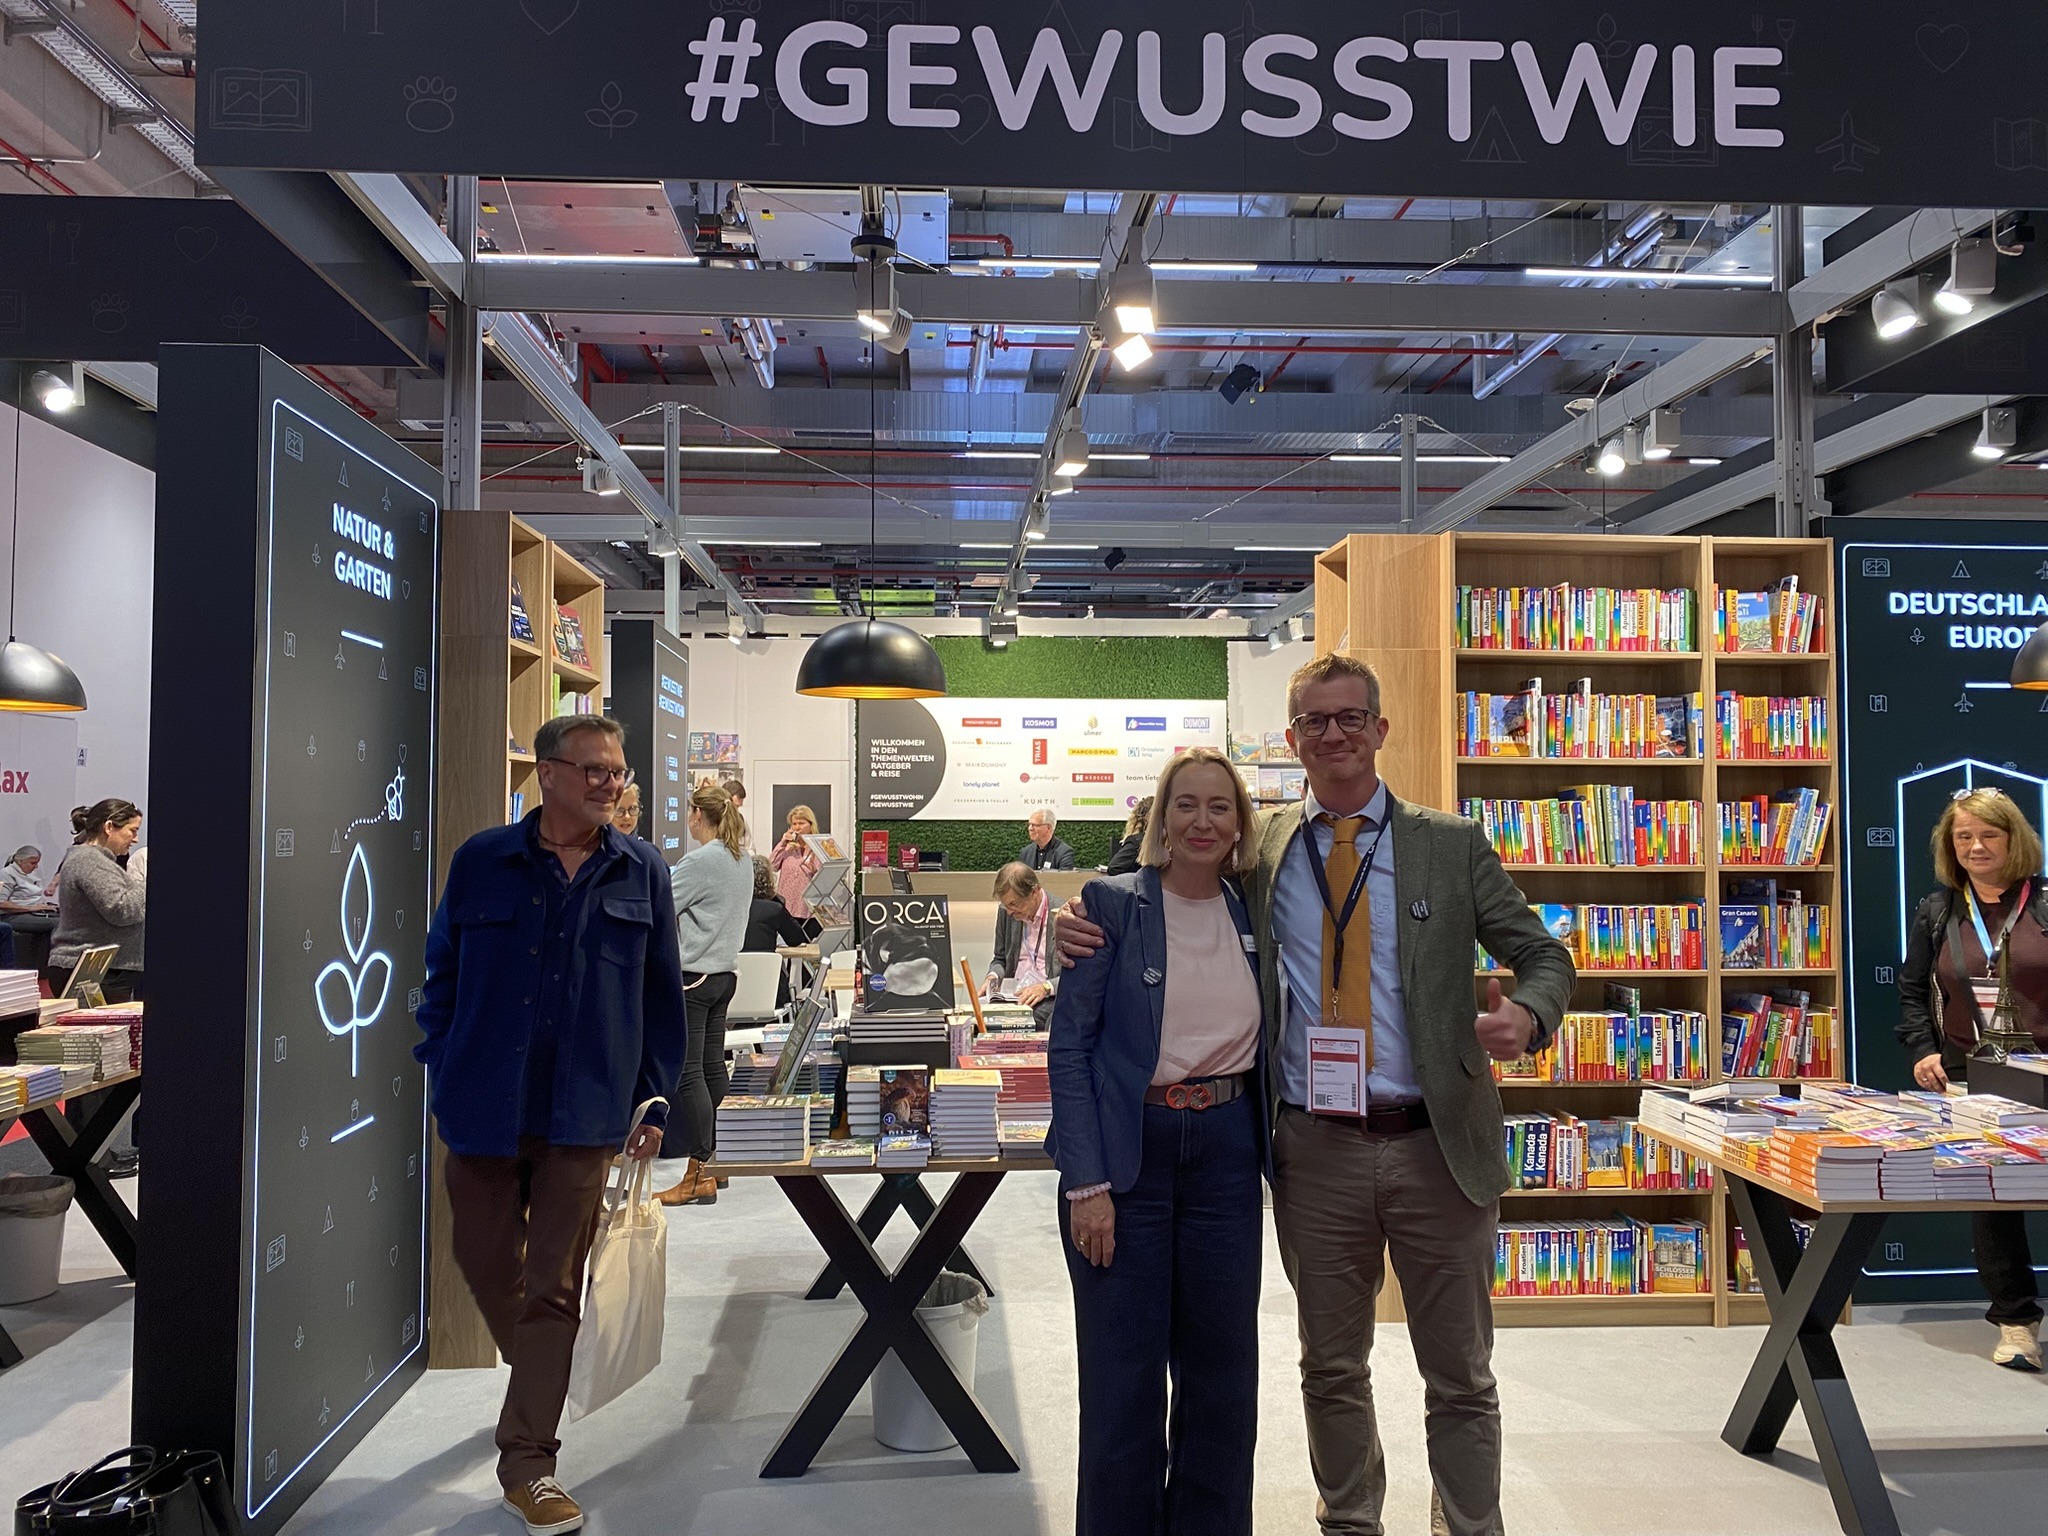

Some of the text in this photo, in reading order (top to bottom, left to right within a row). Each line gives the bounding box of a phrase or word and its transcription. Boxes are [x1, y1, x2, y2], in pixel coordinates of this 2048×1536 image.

[685, 17, 1784, 147] #GEWUSSTWIE
[333, 503, 393, 560] NATUR &
[334, 551, 390, 600] GARTEN
[1780, 595, 1788, 630] BALTIKUM
[1889, 592, 2048, 616] DEUTSCHLA
[1950, 626, 2039, 648] EURO
[1185, 718, 1209, 728] DUMONT
[0, 762, 29, 793] ax
[1553, 810, 1561, 844] Dänemark
[864, 901, 944, 924] ORCA
[1768, 1024, 1777, 1044] Japan
[1617, 1051, 1625, 1077] Irland
[1642, 1052, 1650, 1077] Island
[1770, 1139, 1790, 1153] ALBANIEN
[1775, 1129, 1795, 1143] ALBANIEN
[1525, 1134, 1535, 1170] Kanada
[1536, 1134, 1547, 1170] Kanada
[1770, 1150, 1790, 1164] ALBANIEN
[1770, 1160, 1790, 1175] ALBANIEN
[1771, 1172, 1791, 1186] ALBANIEN
